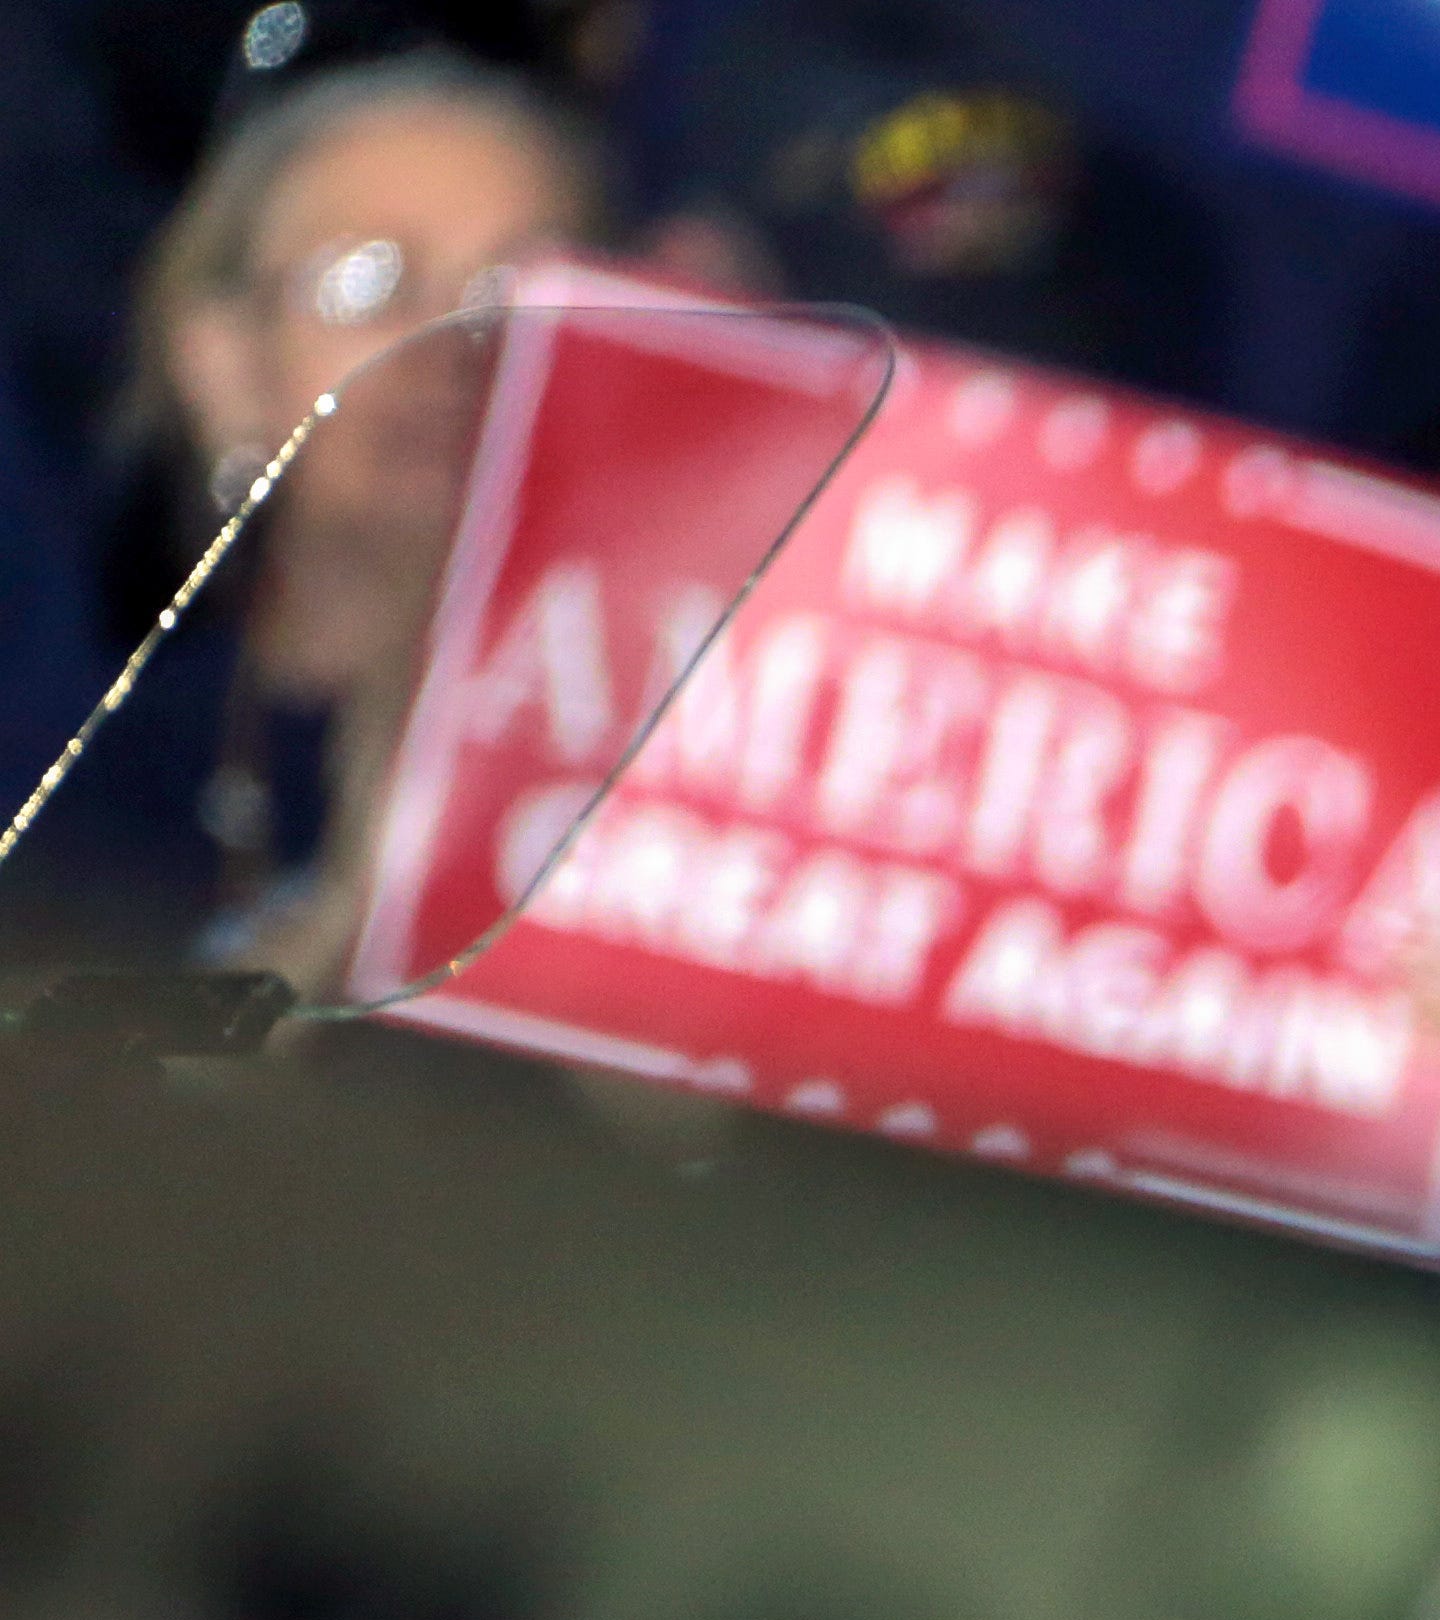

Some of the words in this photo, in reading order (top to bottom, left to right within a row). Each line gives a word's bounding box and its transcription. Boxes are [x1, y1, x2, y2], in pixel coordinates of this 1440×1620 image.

[841, 474, 1238, 692] MAKE
[494, 782, 963, 1005] GREAT
[943, 895, 1412, 1116] AGAIN
